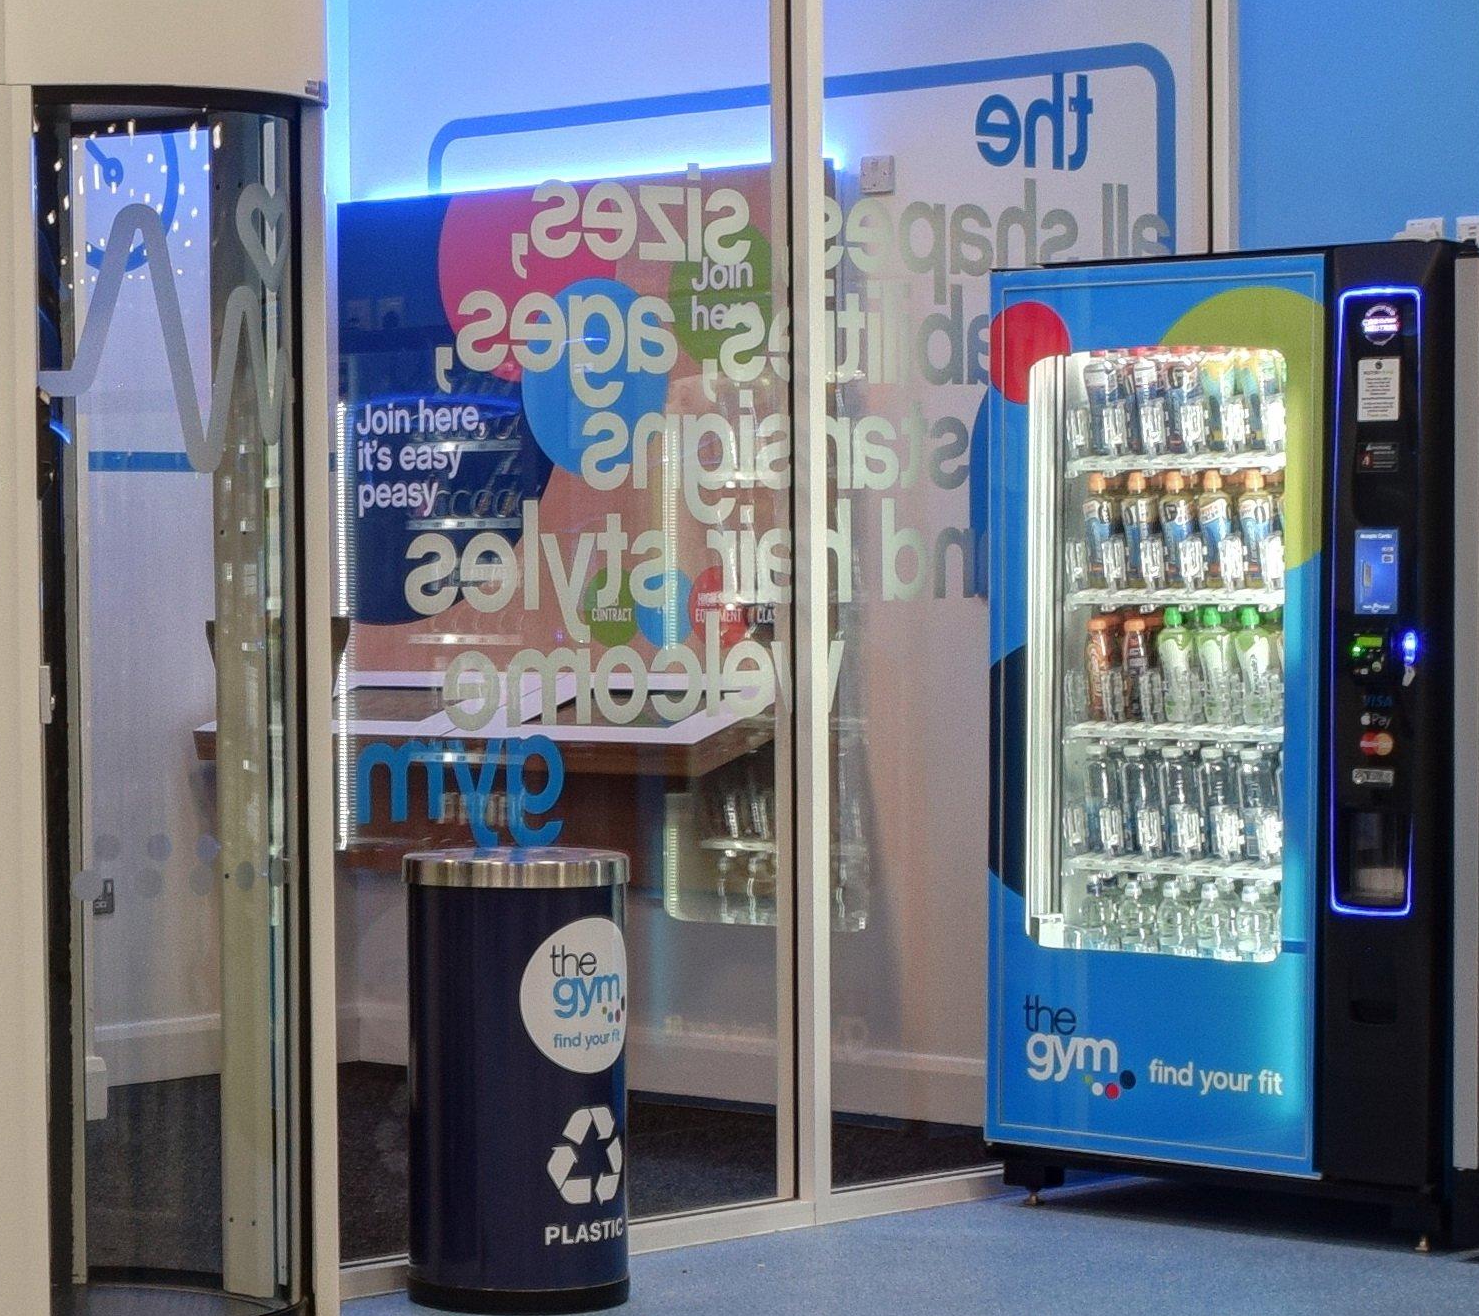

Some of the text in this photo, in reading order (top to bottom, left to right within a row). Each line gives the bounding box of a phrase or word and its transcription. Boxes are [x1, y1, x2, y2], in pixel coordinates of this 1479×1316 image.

[691, 257, 754, 292] Join
[357, 399, 486, 437] Join here,
[357, 439, 462, 478] it's easy
[358, 481, 438, 516] peasy
[550, 945, 598, 978] the
[553, 972, 621, 1020] gym
[1023, 995, 1076, 1035] the
[553, 1027, 621, 1054] find your fit
[1026, 1032, 1118, 1082] gym
[1149, 1058, 1283, 1097] find your fit
[544, 1219, 624, 1246] PLASTIC
